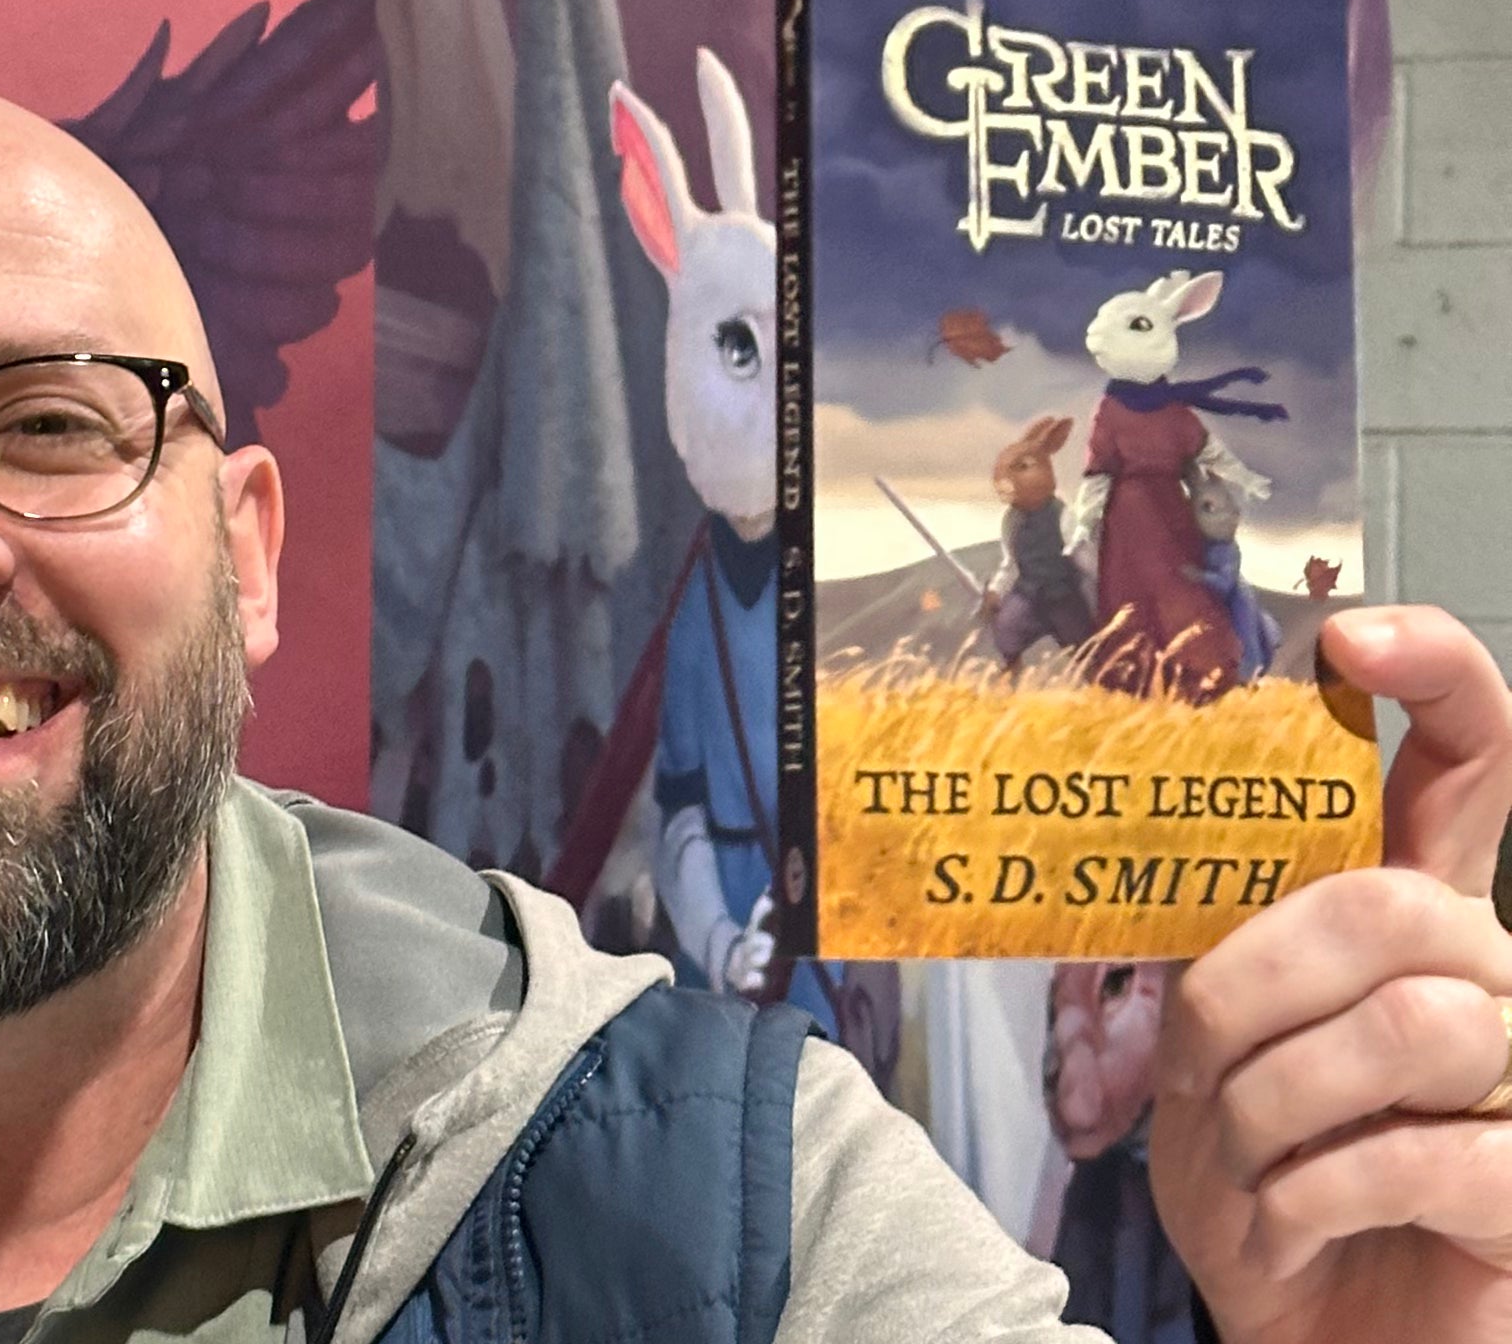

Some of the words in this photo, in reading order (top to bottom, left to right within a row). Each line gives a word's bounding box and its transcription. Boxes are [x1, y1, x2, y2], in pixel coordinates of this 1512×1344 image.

[956, 111, 1306, 254] EMBER
[1060, 212, 1143, 244] LOST
[1150, 217, 1241, 253] TALES
[854, 770, 972, 816] THE
[990, 770, 1130, 820] LOST
[1148, 775, 1357, 823] LEGEND
[925, 852, 974, 906] S.
[990, 854, 1044, 906] D.
[1064, 854, 1291, 907] SMITH
